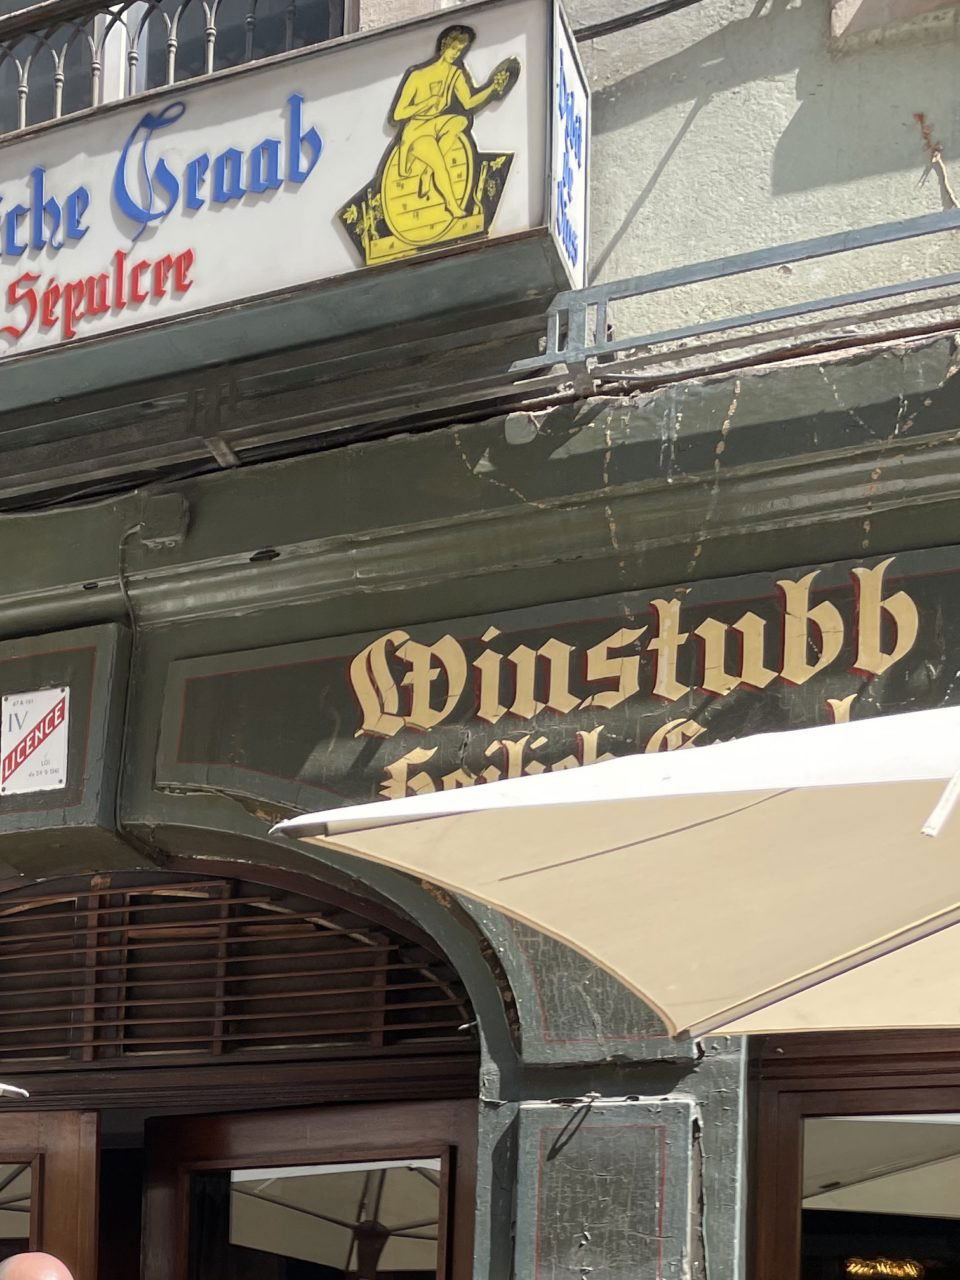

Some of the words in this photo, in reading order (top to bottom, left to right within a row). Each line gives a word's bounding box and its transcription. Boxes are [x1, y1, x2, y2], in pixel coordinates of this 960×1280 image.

[113, 92, 324, 241] Graab
[349, 556, 919, 738] Winstubb
[4, 702, 64, 778] LICENCE
[8, 711, 29, 732] IV
